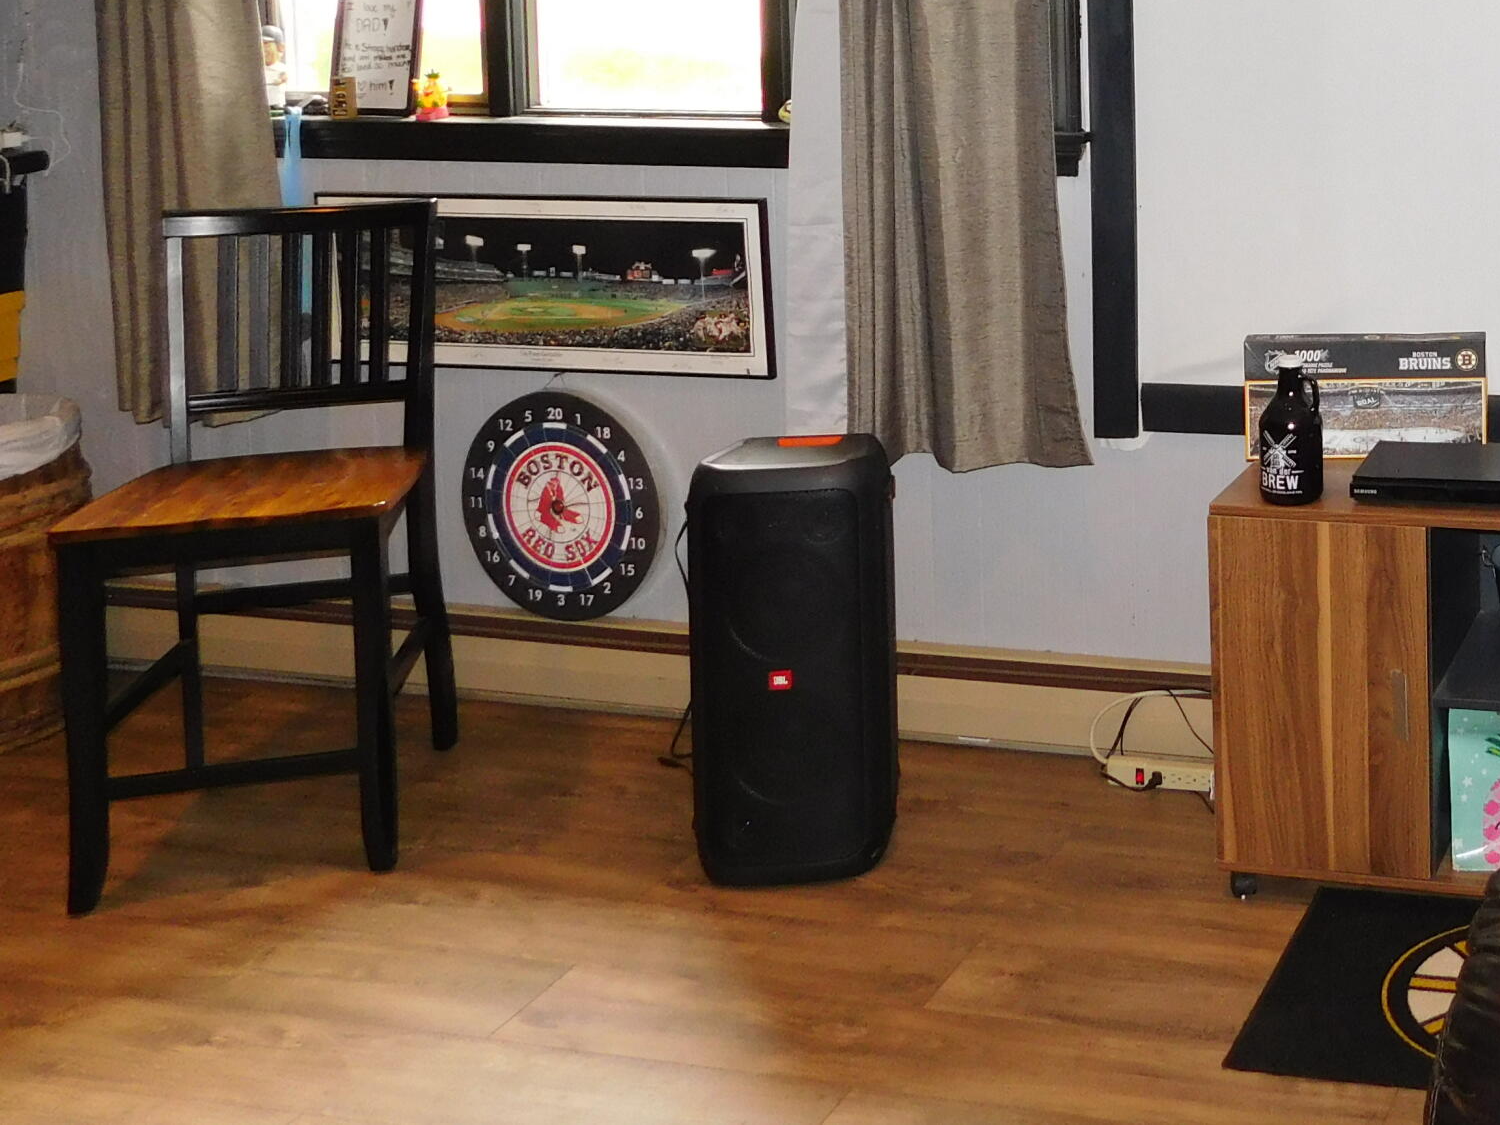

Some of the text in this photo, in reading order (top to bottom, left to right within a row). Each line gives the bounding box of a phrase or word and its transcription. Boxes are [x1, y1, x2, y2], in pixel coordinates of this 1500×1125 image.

[356, 17, 389, 36] DAD!
[1398, 357, 1451, 370] BRUINS
[524, 410, 532, 422] 5
[546, 407, 563, 420] 20
[575, 413, 581, 425] 1
[498, 419, 513, 431] 12
[596, 426, 611, 439] 18
[487, 440, 495, 452] 9
[617, 450, 625, 462] 4
[470, 467, 484, 480] 14
[516, 453, 600, 492] BOSTON
[629, 478, 644, 490] 13
[1262, 472, 1299, 490] BREW
[470, 496, 482, 508] 11
[635, 507, 644, 519] 6
[479, 525, 487, 537] 8
[521, 526, 599, 562] RED SOX
[631, 537, 646, 550] 10
[486, 550, 500, 563] 16
[620, 563, 635, 576] 15
[508, 575, 516, 586] 7
[603, 581, 611, 594] 2
[528, 588, 543, 601] 19
[557, 594, 565, 606] 3
[579, 594, 594, 606] 17
